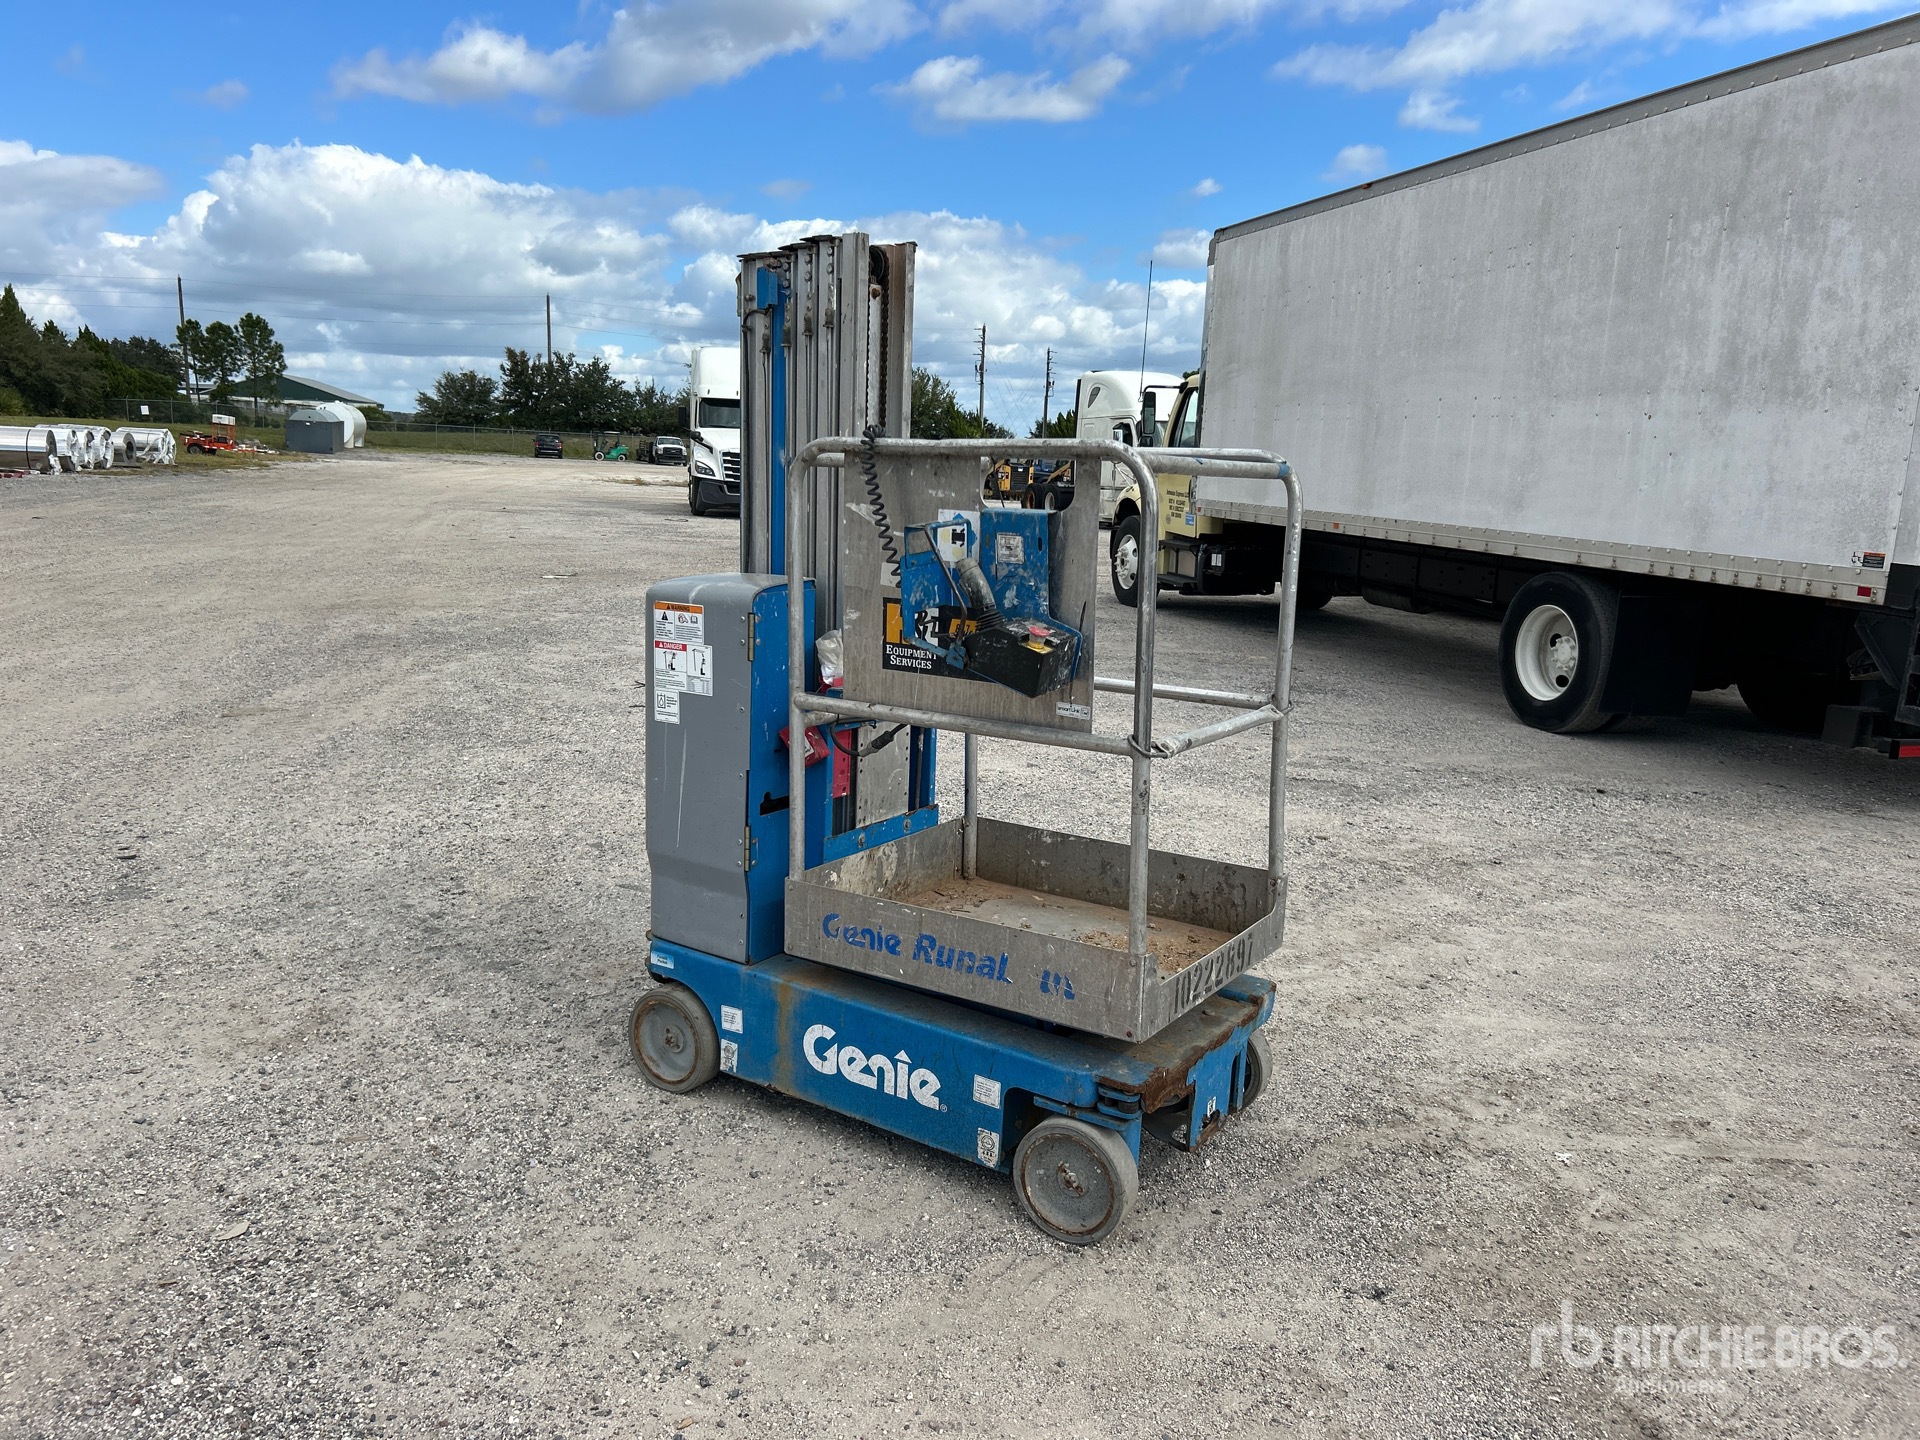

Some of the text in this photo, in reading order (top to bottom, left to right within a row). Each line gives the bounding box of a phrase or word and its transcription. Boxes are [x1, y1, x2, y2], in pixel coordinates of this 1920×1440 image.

[890, 655, 932, 669] SERVICES
[822, 912, 902, 957] Genie
[803, 1023, 942, 1111] Genie
